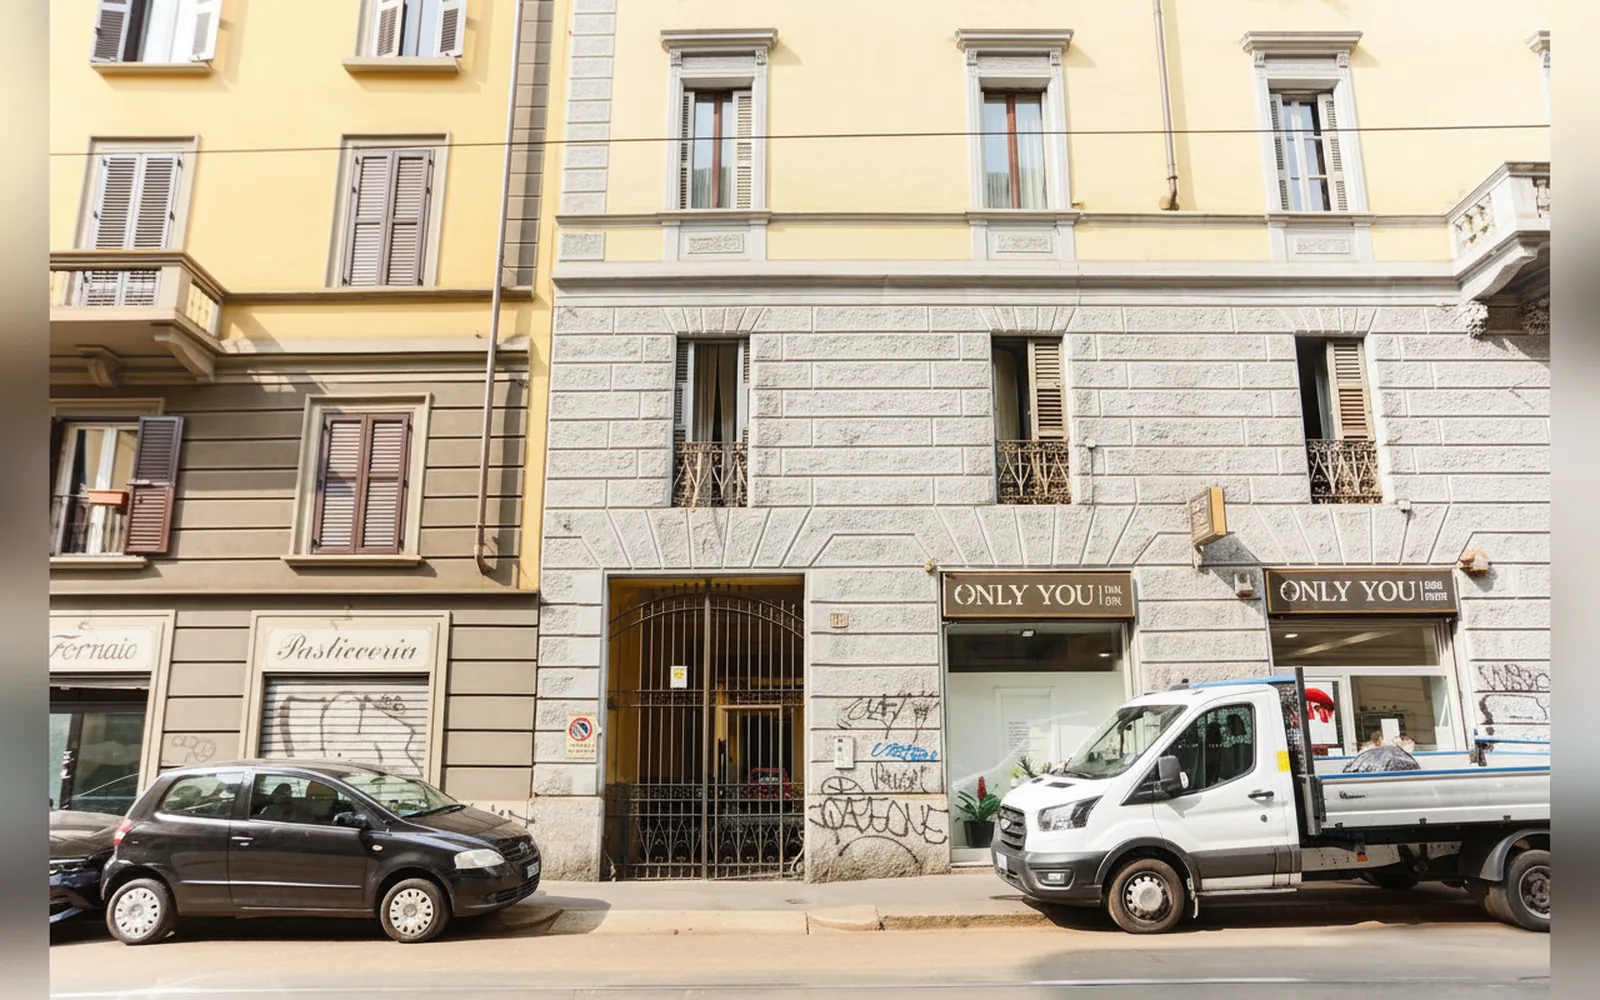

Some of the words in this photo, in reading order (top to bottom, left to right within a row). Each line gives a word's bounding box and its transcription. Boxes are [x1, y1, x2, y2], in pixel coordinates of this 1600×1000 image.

[954, 584, 1029, 606] ONLY
[1036, 584, 1094, 606] YOU
[1280, 580, 1352, 602] ONLY
[1359, 580, 1416, 602] YOU
[277, 633, 417, 660] Pasticceria
